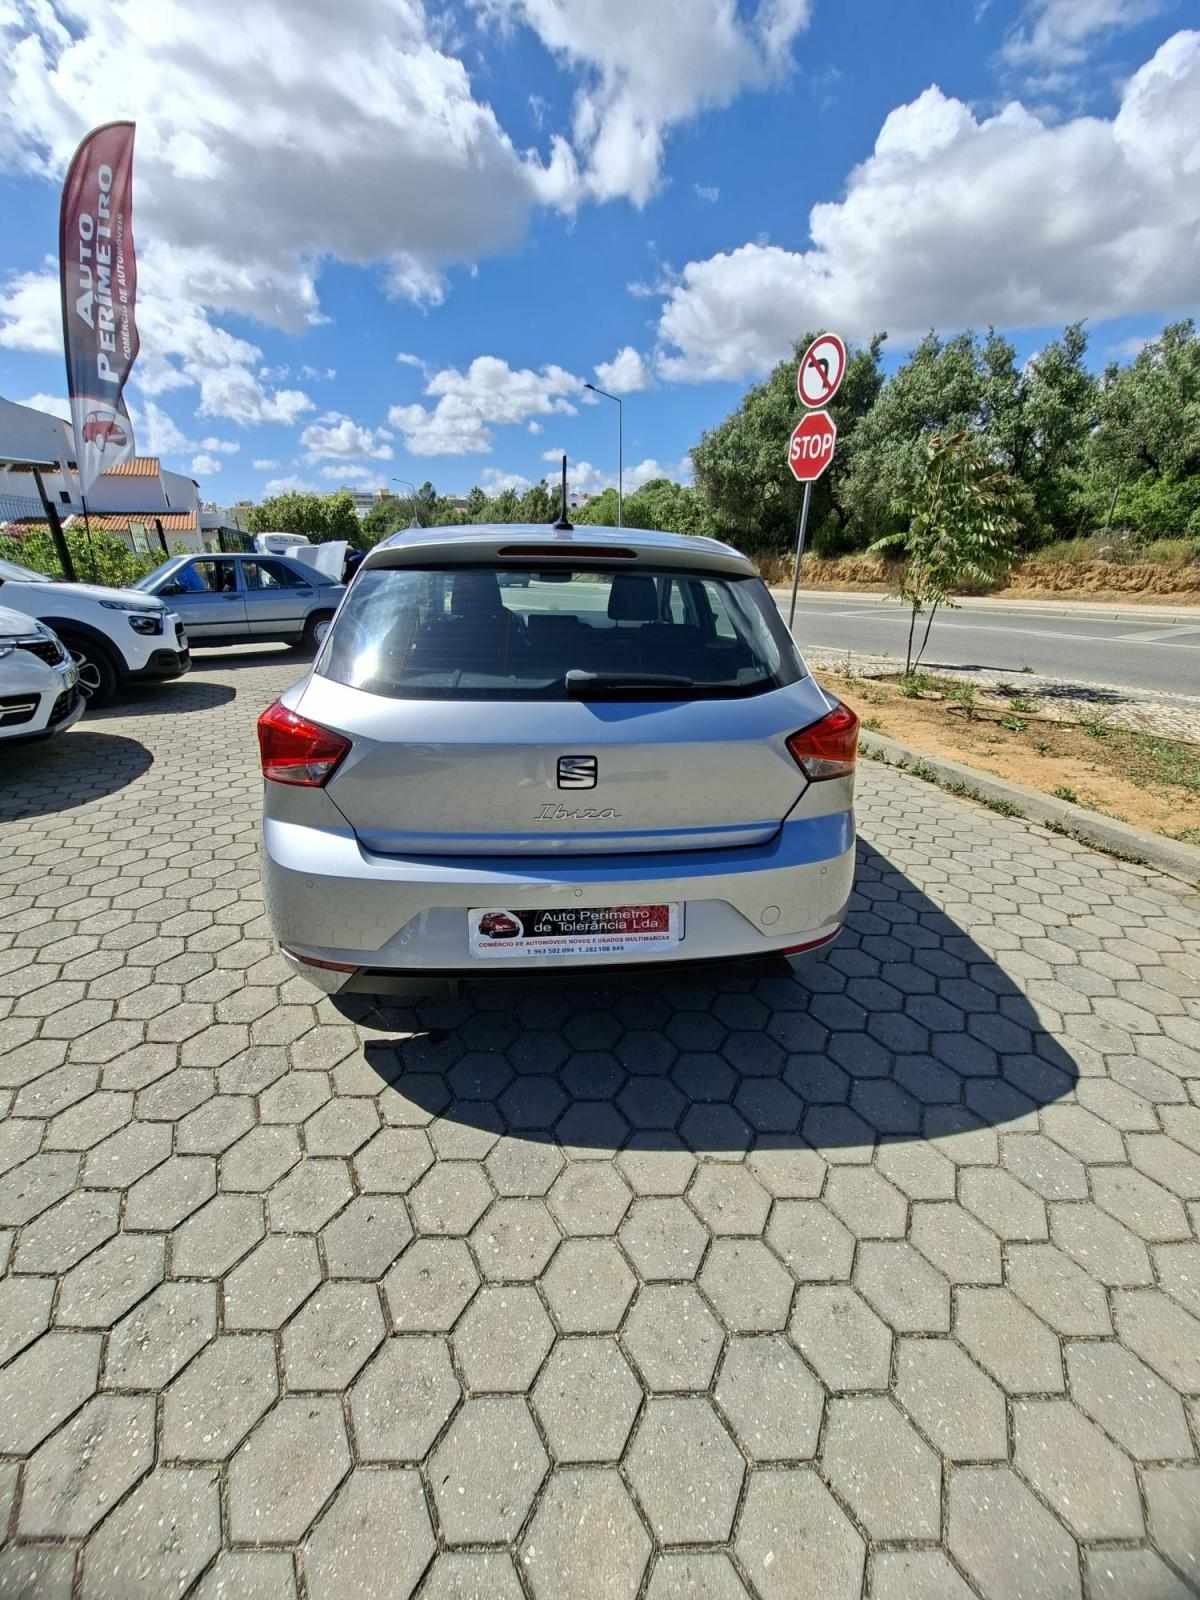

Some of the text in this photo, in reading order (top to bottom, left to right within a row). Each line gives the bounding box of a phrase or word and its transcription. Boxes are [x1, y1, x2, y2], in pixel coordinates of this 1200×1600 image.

[76, 213, 94, 329] AUTO
[120, 290, 128, 303] DE
[791, 433, 833, 461] STOP
[533, 803, 622, 822] Ibiza
[542, 911, 576, 922] Auto
[534, 919, 658, 933] de Tolerância Lda
